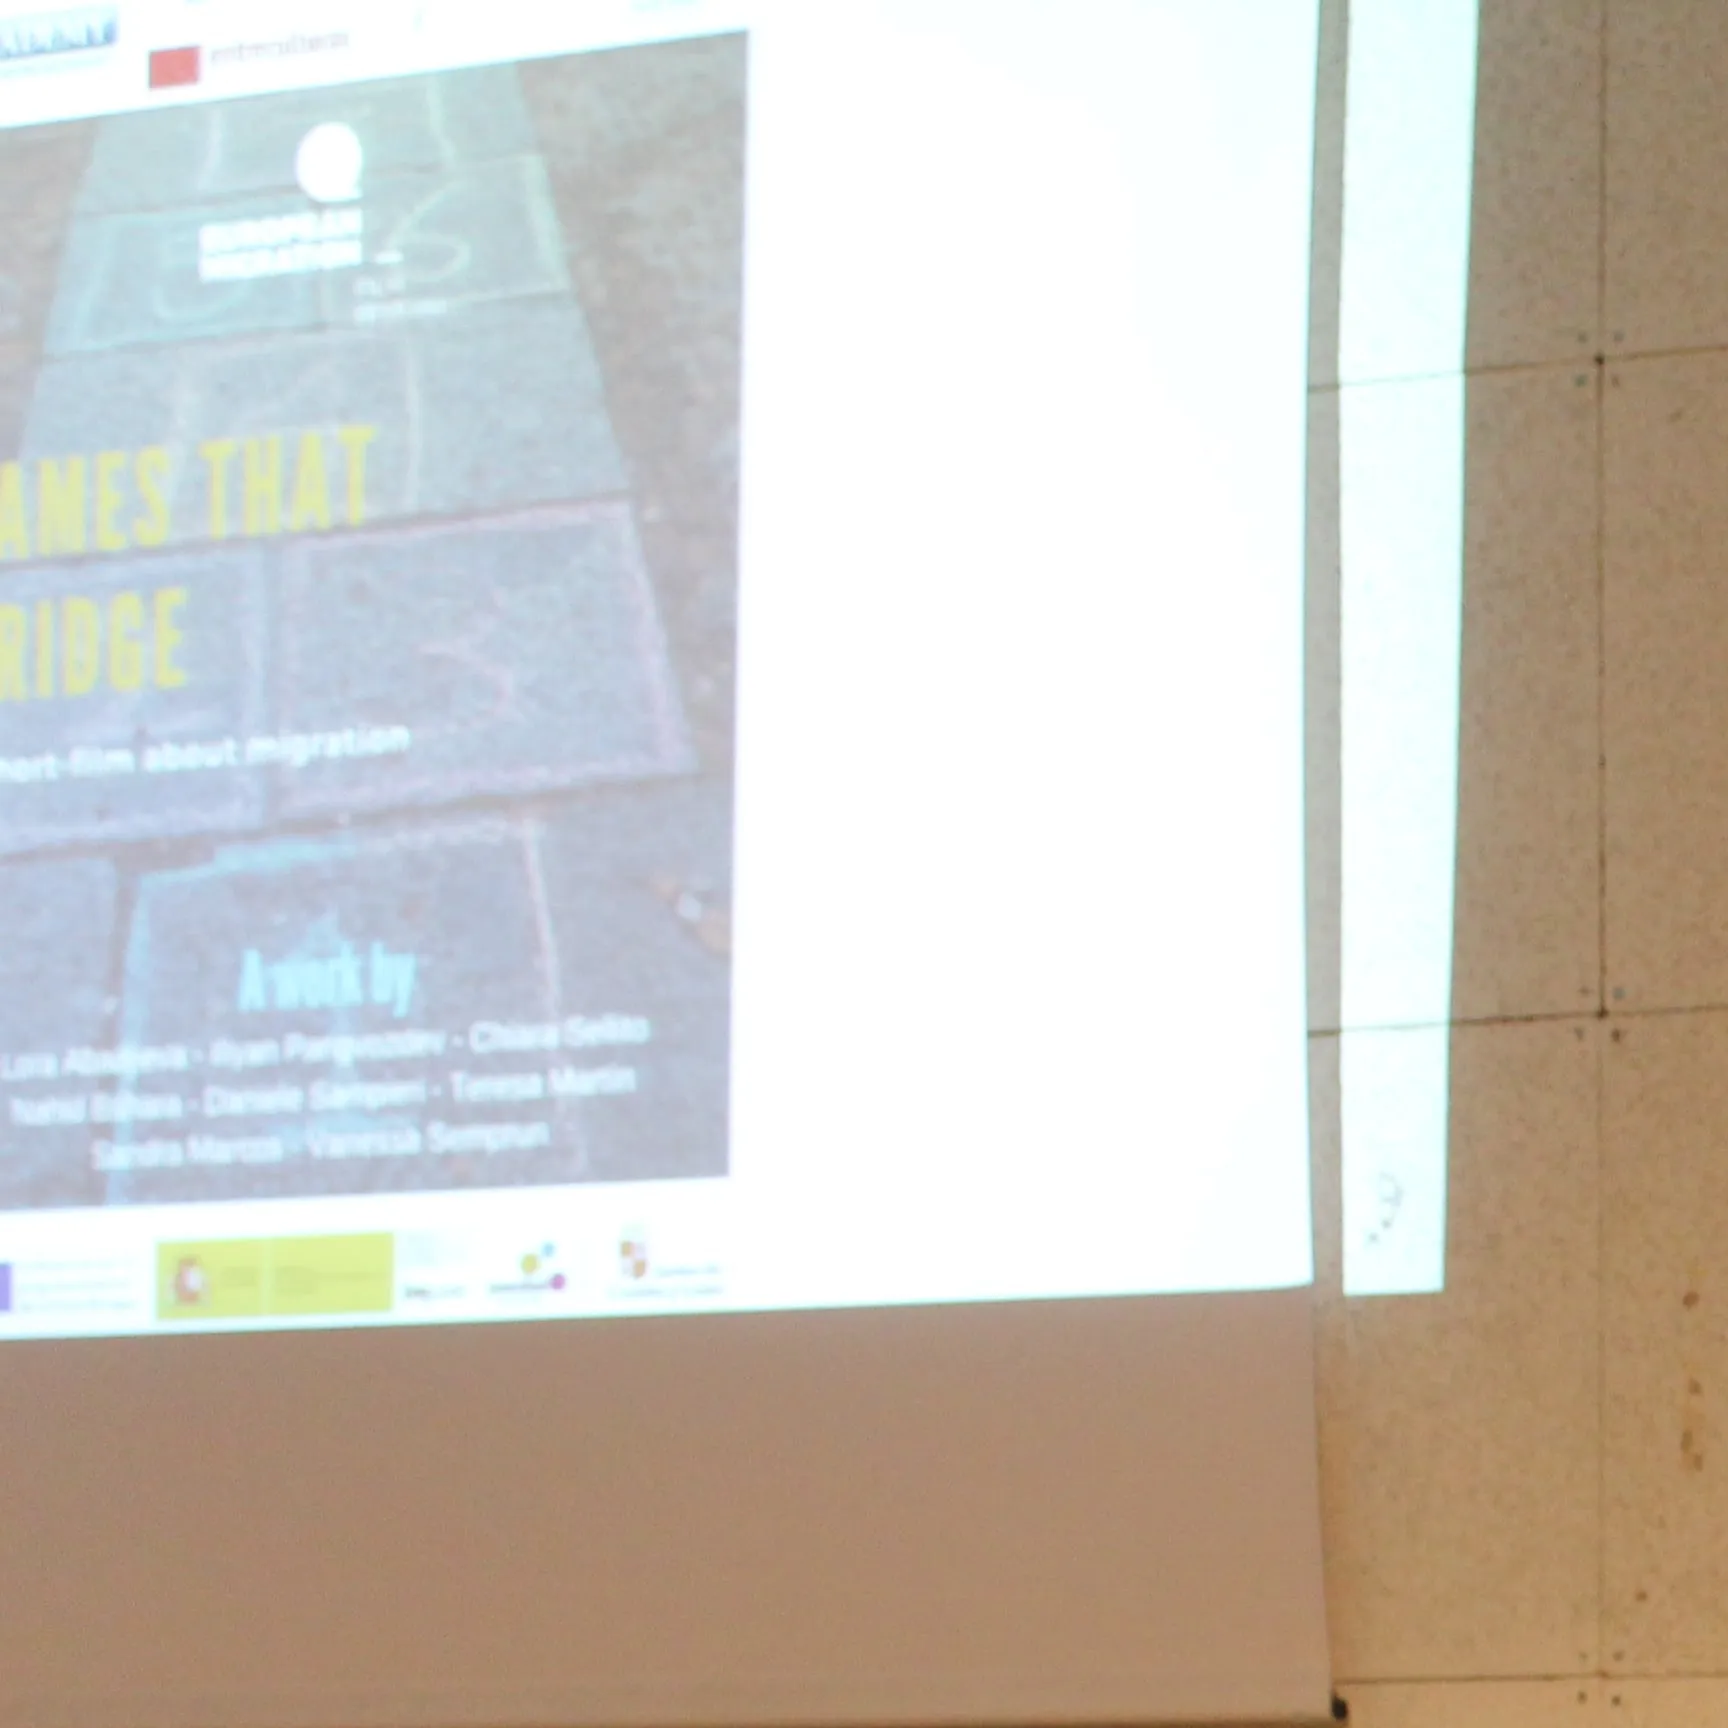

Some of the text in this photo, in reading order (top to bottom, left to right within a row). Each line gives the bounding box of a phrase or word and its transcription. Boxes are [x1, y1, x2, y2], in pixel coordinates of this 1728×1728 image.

[198, 425, 378, 542] THAT
[144, 735, 238, 773] about
[246, 725, 410, 768] migration
